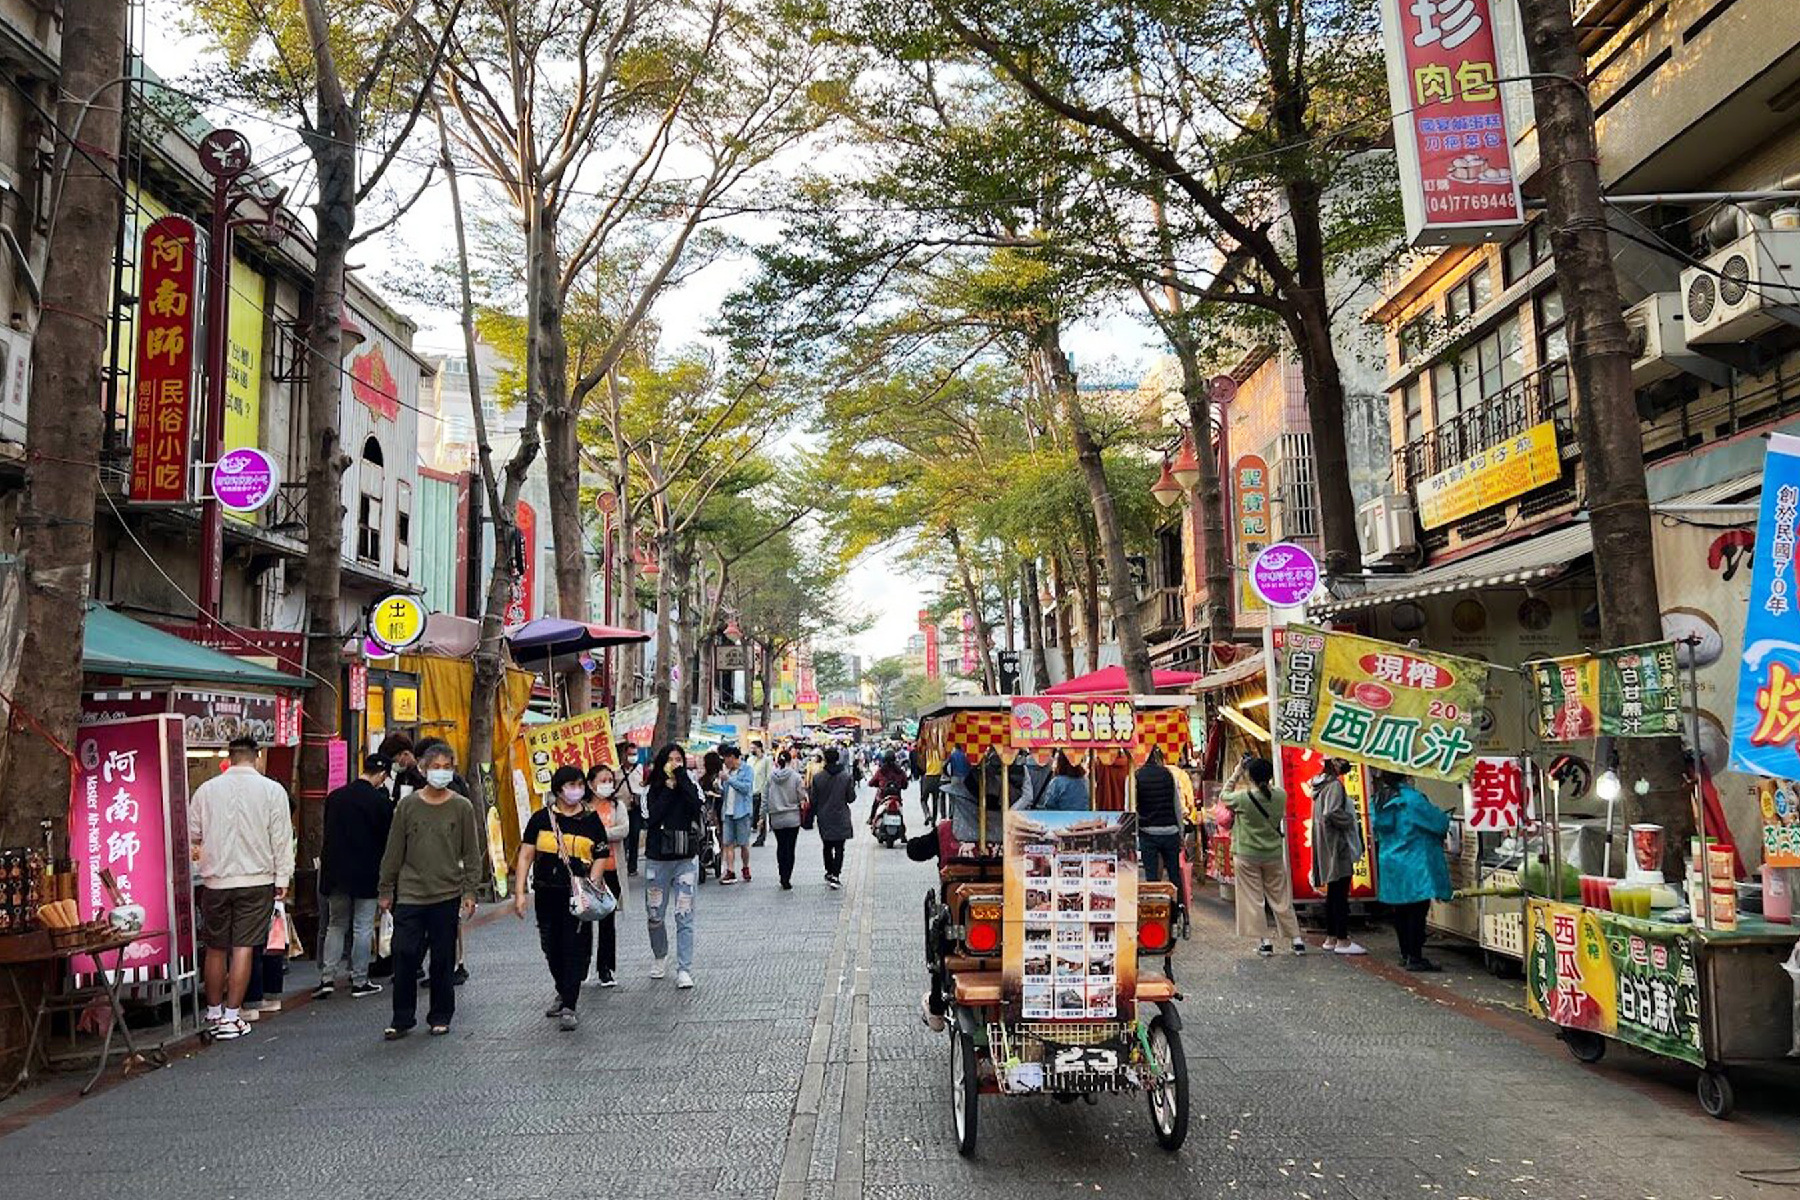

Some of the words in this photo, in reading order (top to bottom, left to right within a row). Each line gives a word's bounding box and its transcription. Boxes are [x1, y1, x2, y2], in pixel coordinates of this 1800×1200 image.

[1414, 60, 1498, 106] 肉包
[1425, 193, 1516, 214] (04)7769448
[146, 234, 190, 366] 阿南師
[155, 379, 184, 490] 民俗小吃
[1764, 484, 1800, 617] 創於民國70年
[1288, 632, 1326, 651] 巴西
[1372, 652, 1438, 690] 現榨
[1069, 701, 1134, 741] 五倍券
[1282, 651, 1315, 742] 白甘蔗汁
[1560, 666, 1582, 739] 西瓜汁
[1621, 668, 1642, 734] 白甘蔗汁
[551, 731, 614, 769] 特價
[1319, 701, 1473, 774] 西瓜汁
[86, 775, 99, 808] Master
[103, 749, 140, 872] 阿南師
[1470, 760, 1533, 827] 熱
[89, 854, 103, 907] Traditional
[1553, 914, 1587, 1017] 西瓜汁
[1629, 934, 1668, 970] 巴西
